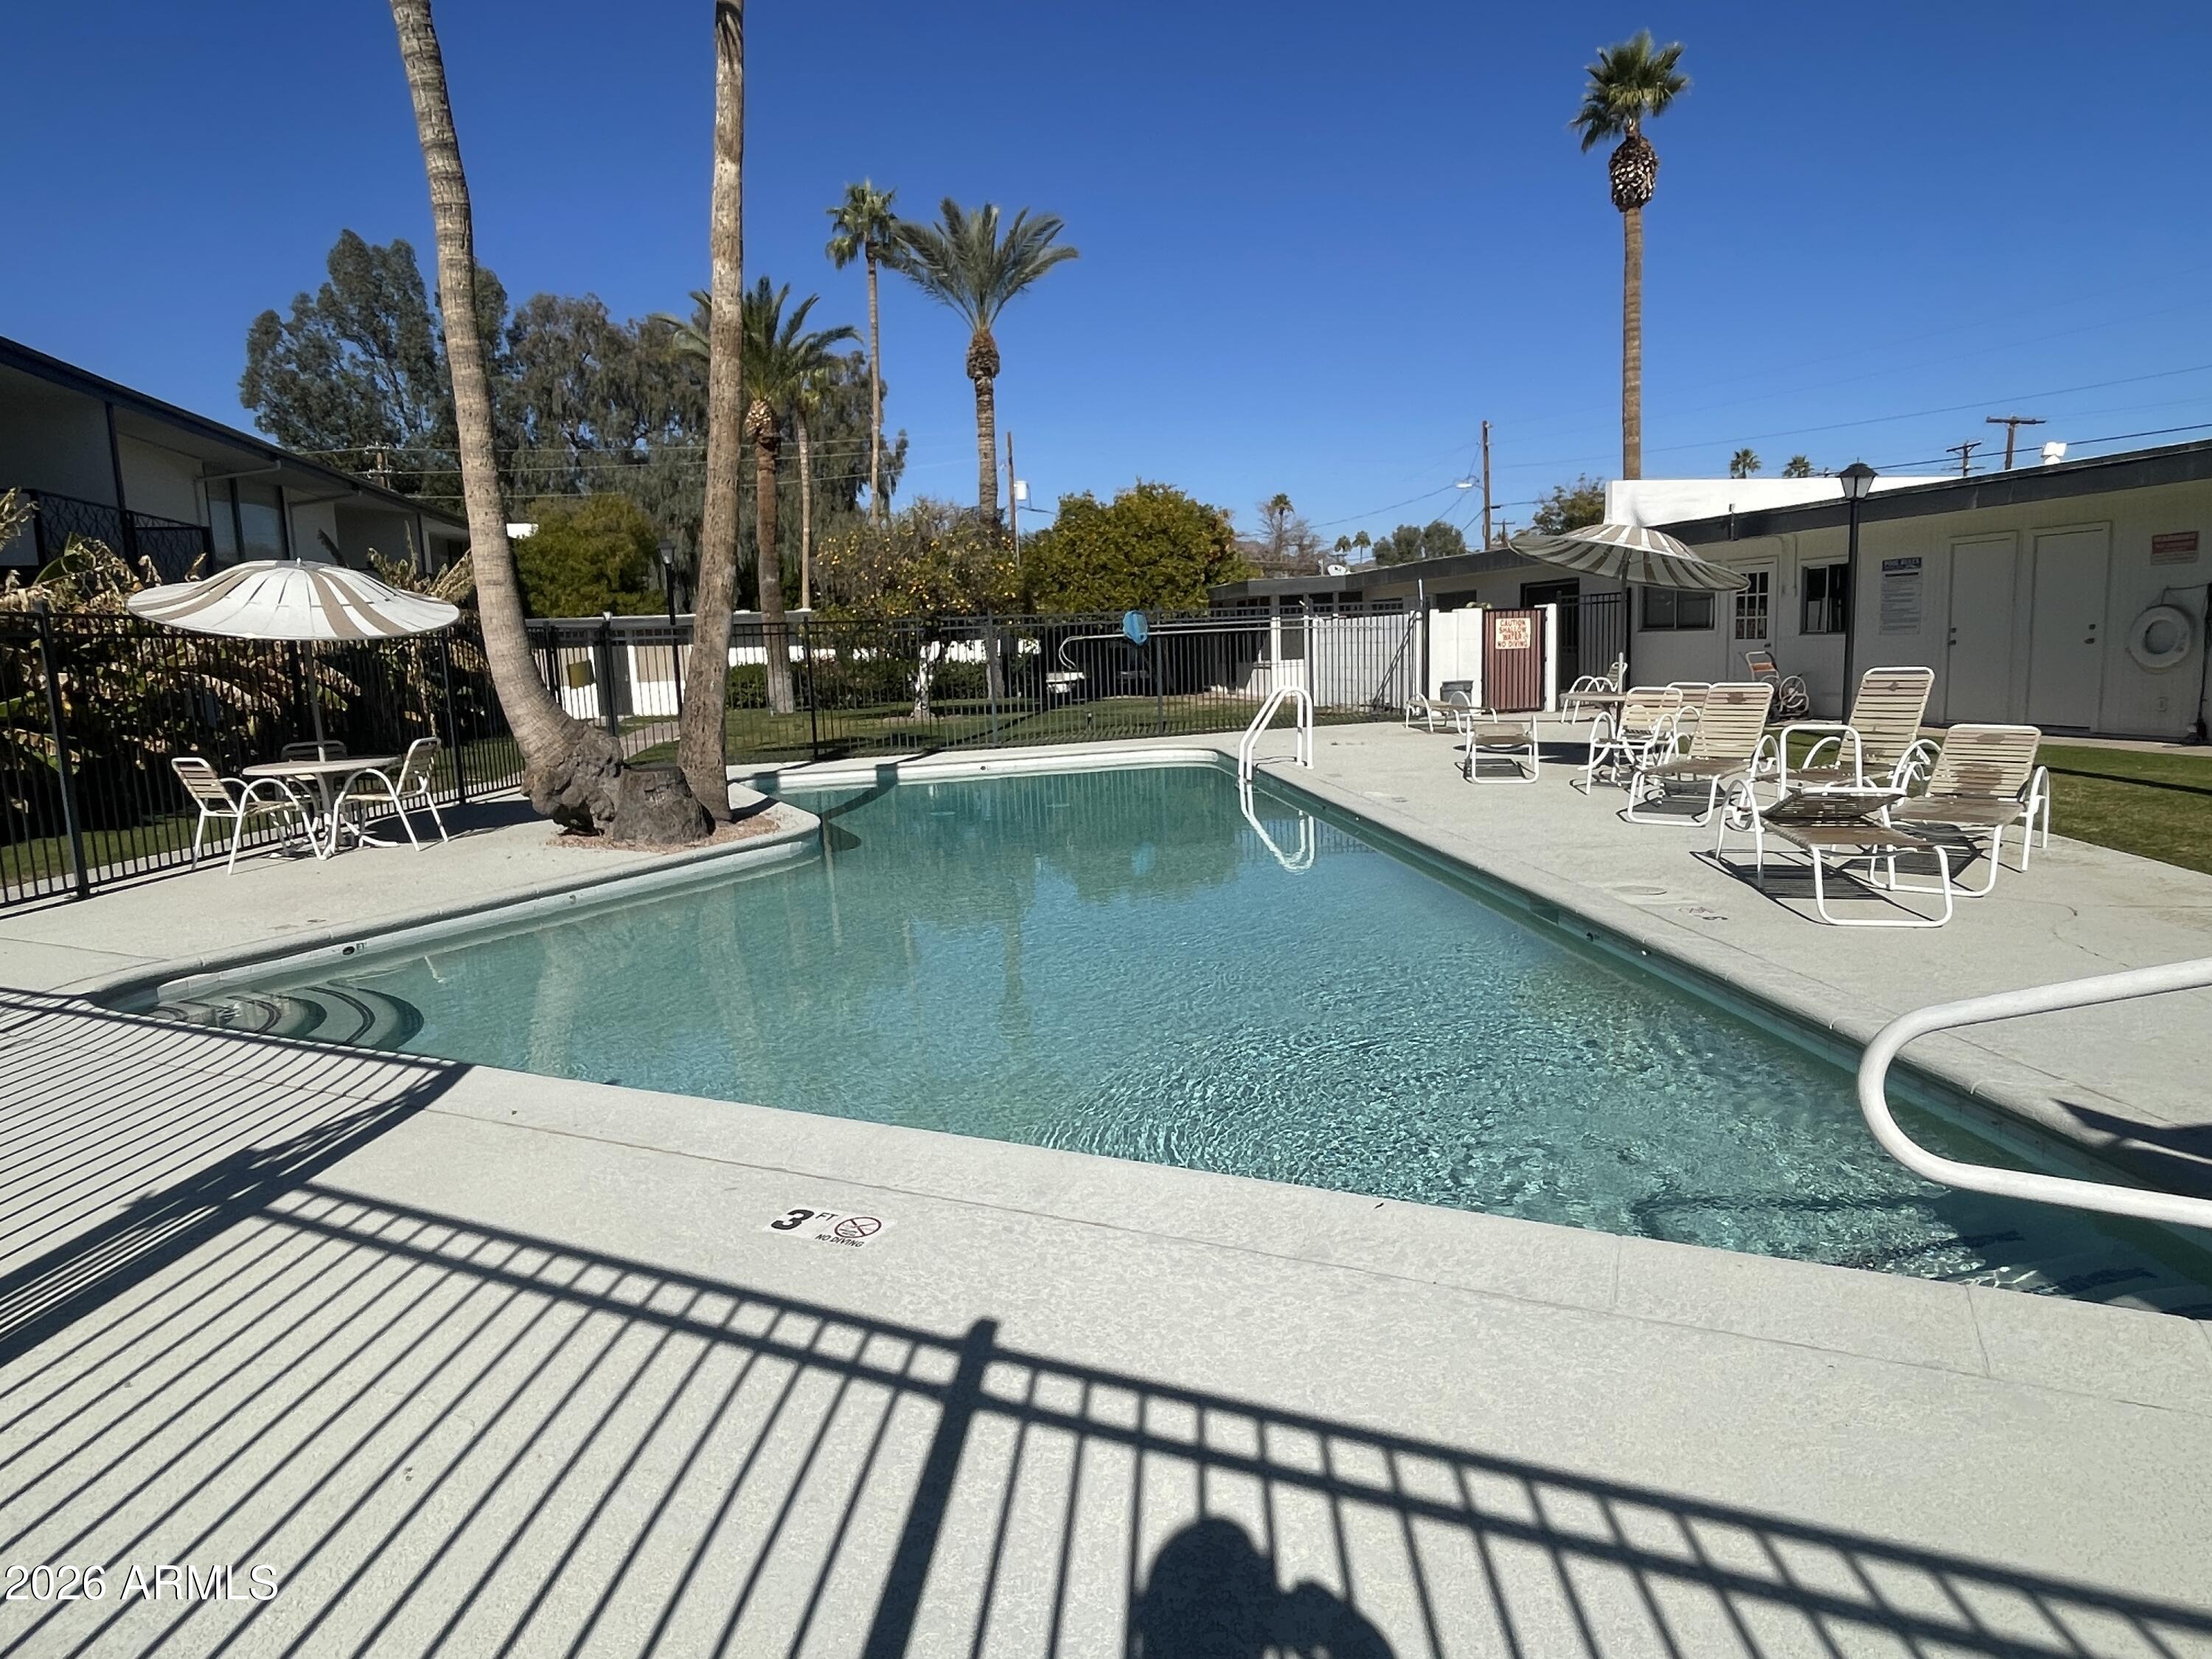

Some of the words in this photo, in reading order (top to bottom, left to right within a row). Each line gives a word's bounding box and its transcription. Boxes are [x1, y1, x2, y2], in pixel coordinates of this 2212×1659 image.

[1503, 632, 1522, 640] WATER
[1508, 639, 1528, 647] DIVING
[771, 1209, 815, 1230] 3
[815, 1212, 838, 1221] FT
[830, 1237, 864, 1248] DIVING
